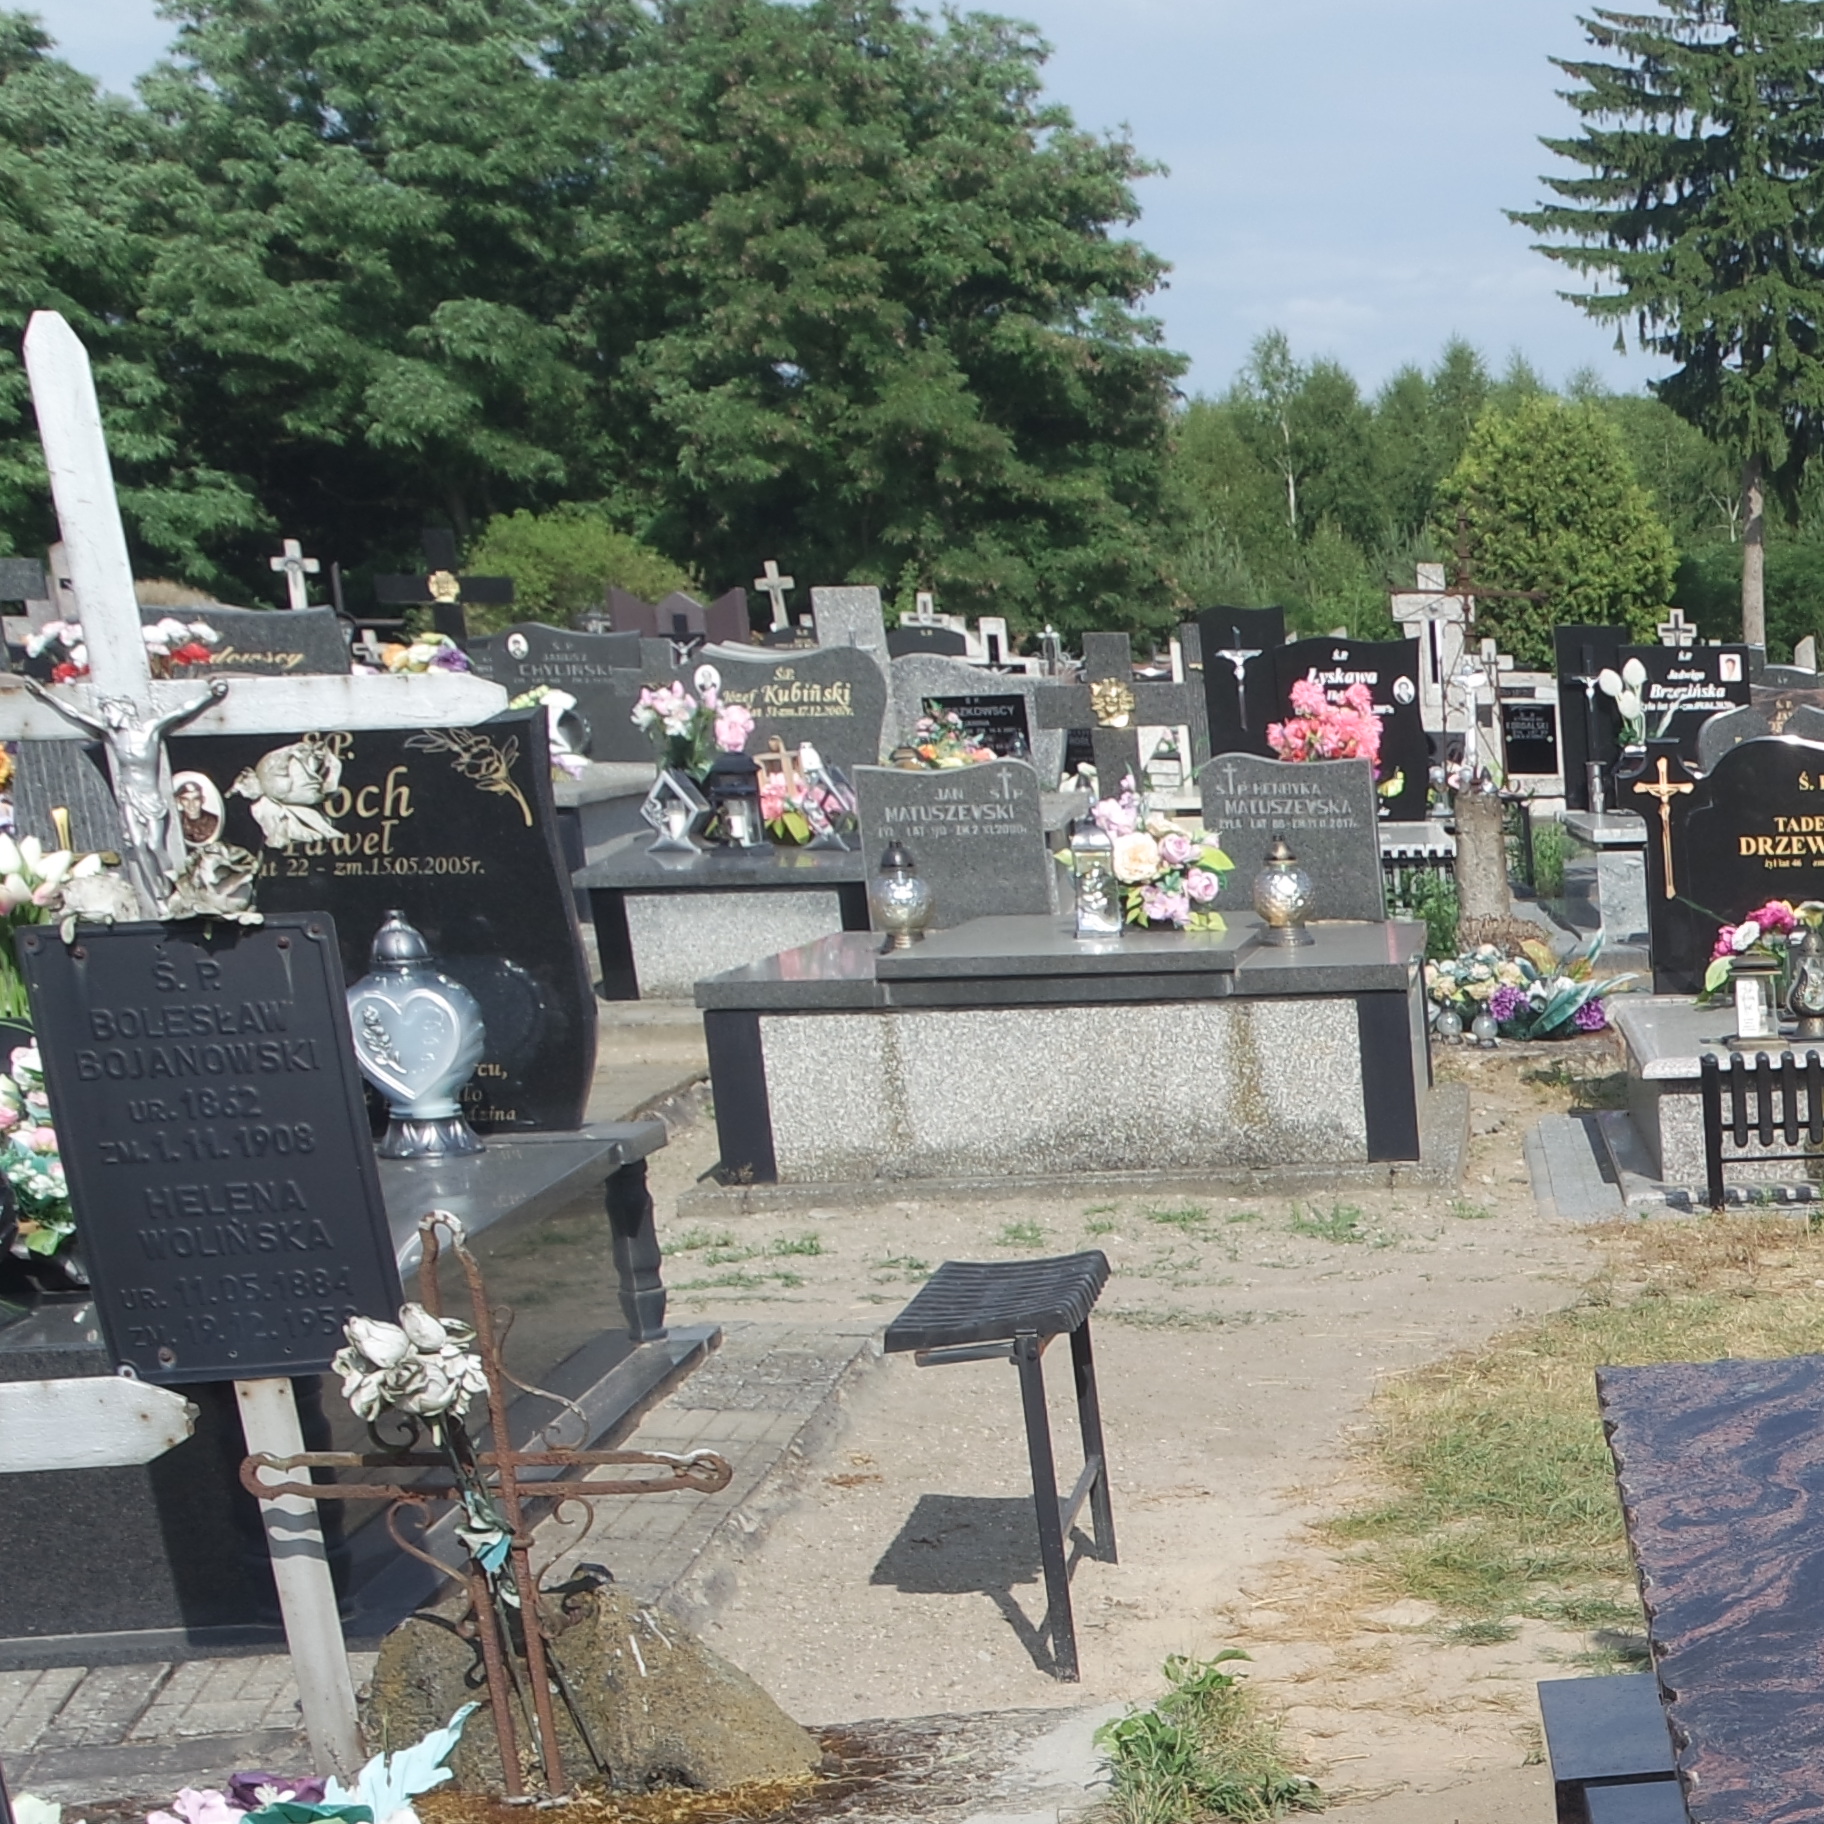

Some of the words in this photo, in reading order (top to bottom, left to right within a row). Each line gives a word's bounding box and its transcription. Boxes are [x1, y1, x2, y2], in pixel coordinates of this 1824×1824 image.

[322, 765, 414, 820] och
[285, 857, 309, 876] 22
[89, 1001, 288, 1041] BOLESŁAW
[76, 1039, 322, 1083] BOJANOWSKI
[129, 1098, 179, 1123] UR.
[144, 1179, 309, 1220] HELENA
[136, 1217, 336, 1261] WOLIŃSKA
[119, 1286, 168, 1311] UR.
